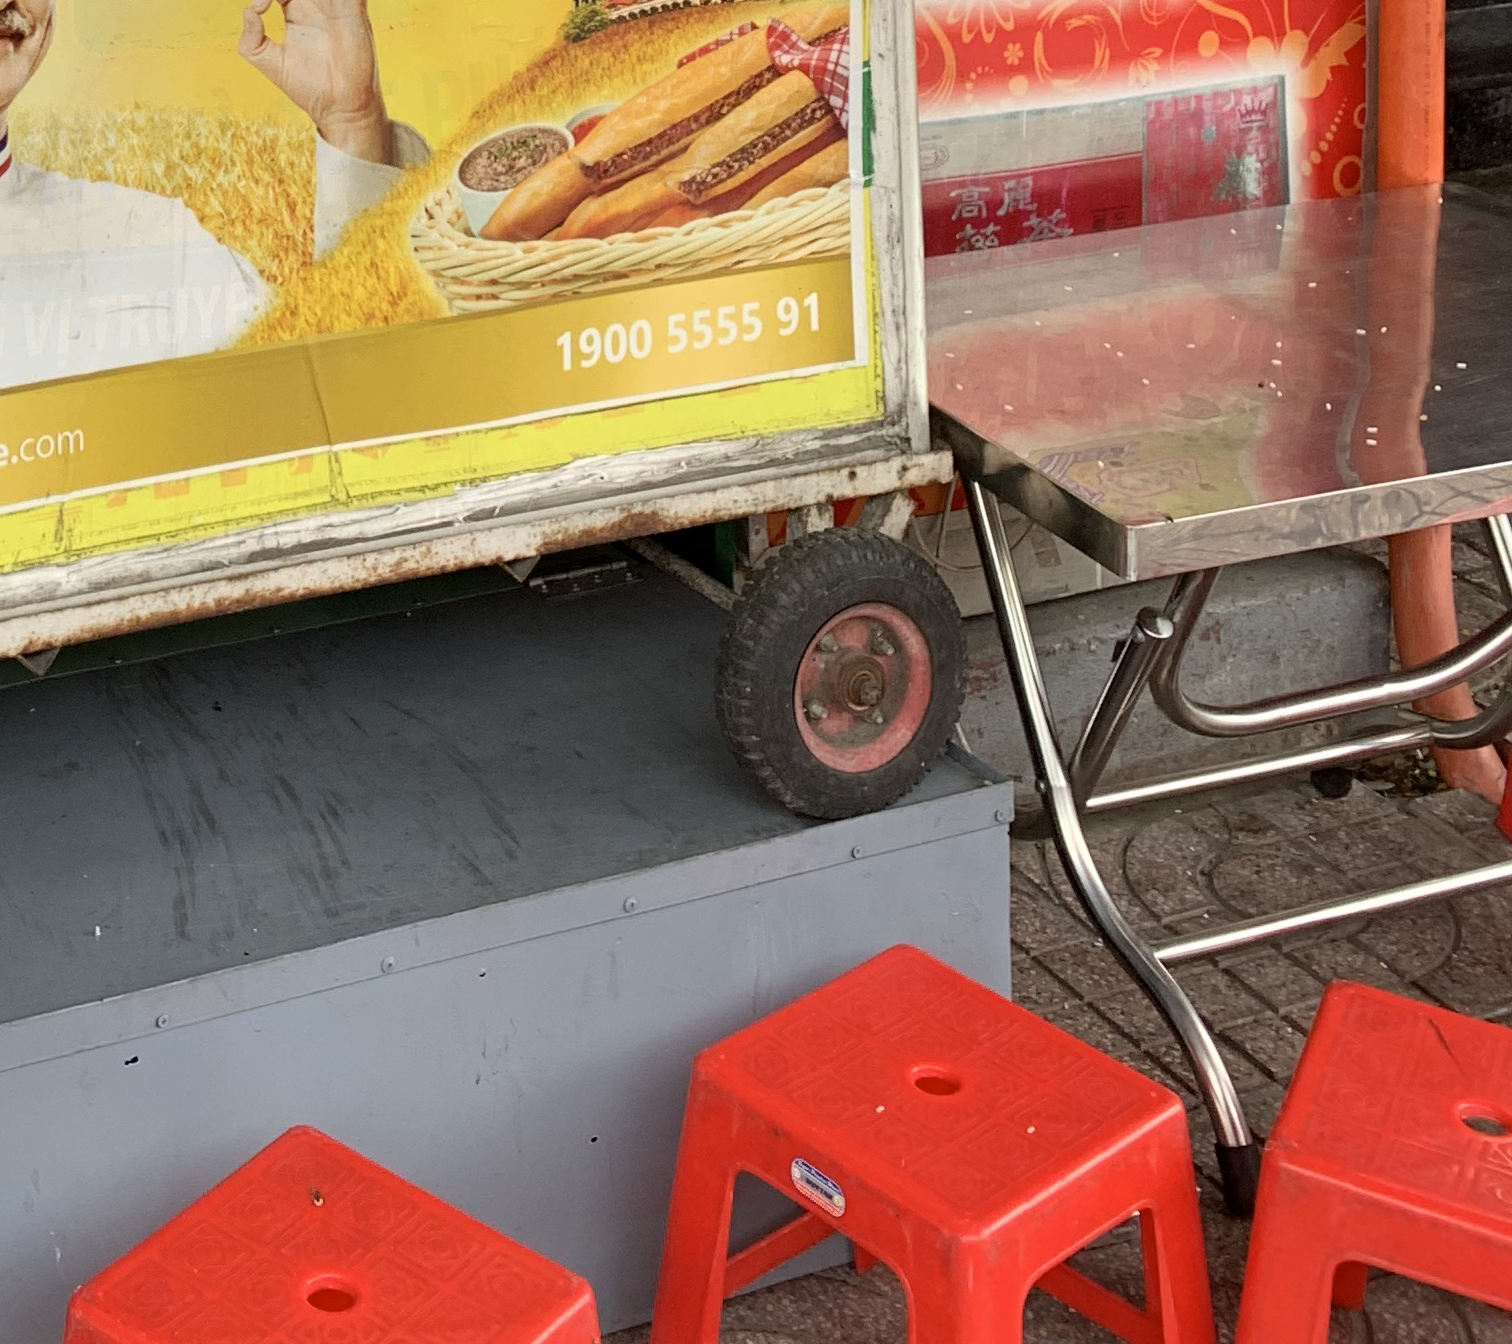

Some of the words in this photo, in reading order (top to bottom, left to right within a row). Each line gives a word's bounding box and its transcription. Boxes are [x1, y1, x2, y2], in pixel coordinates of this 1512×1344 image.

[555, 318, 651, 372] 1900
[665, 305, 764, 360] 5555
[776, 291, 823, 339] 91
